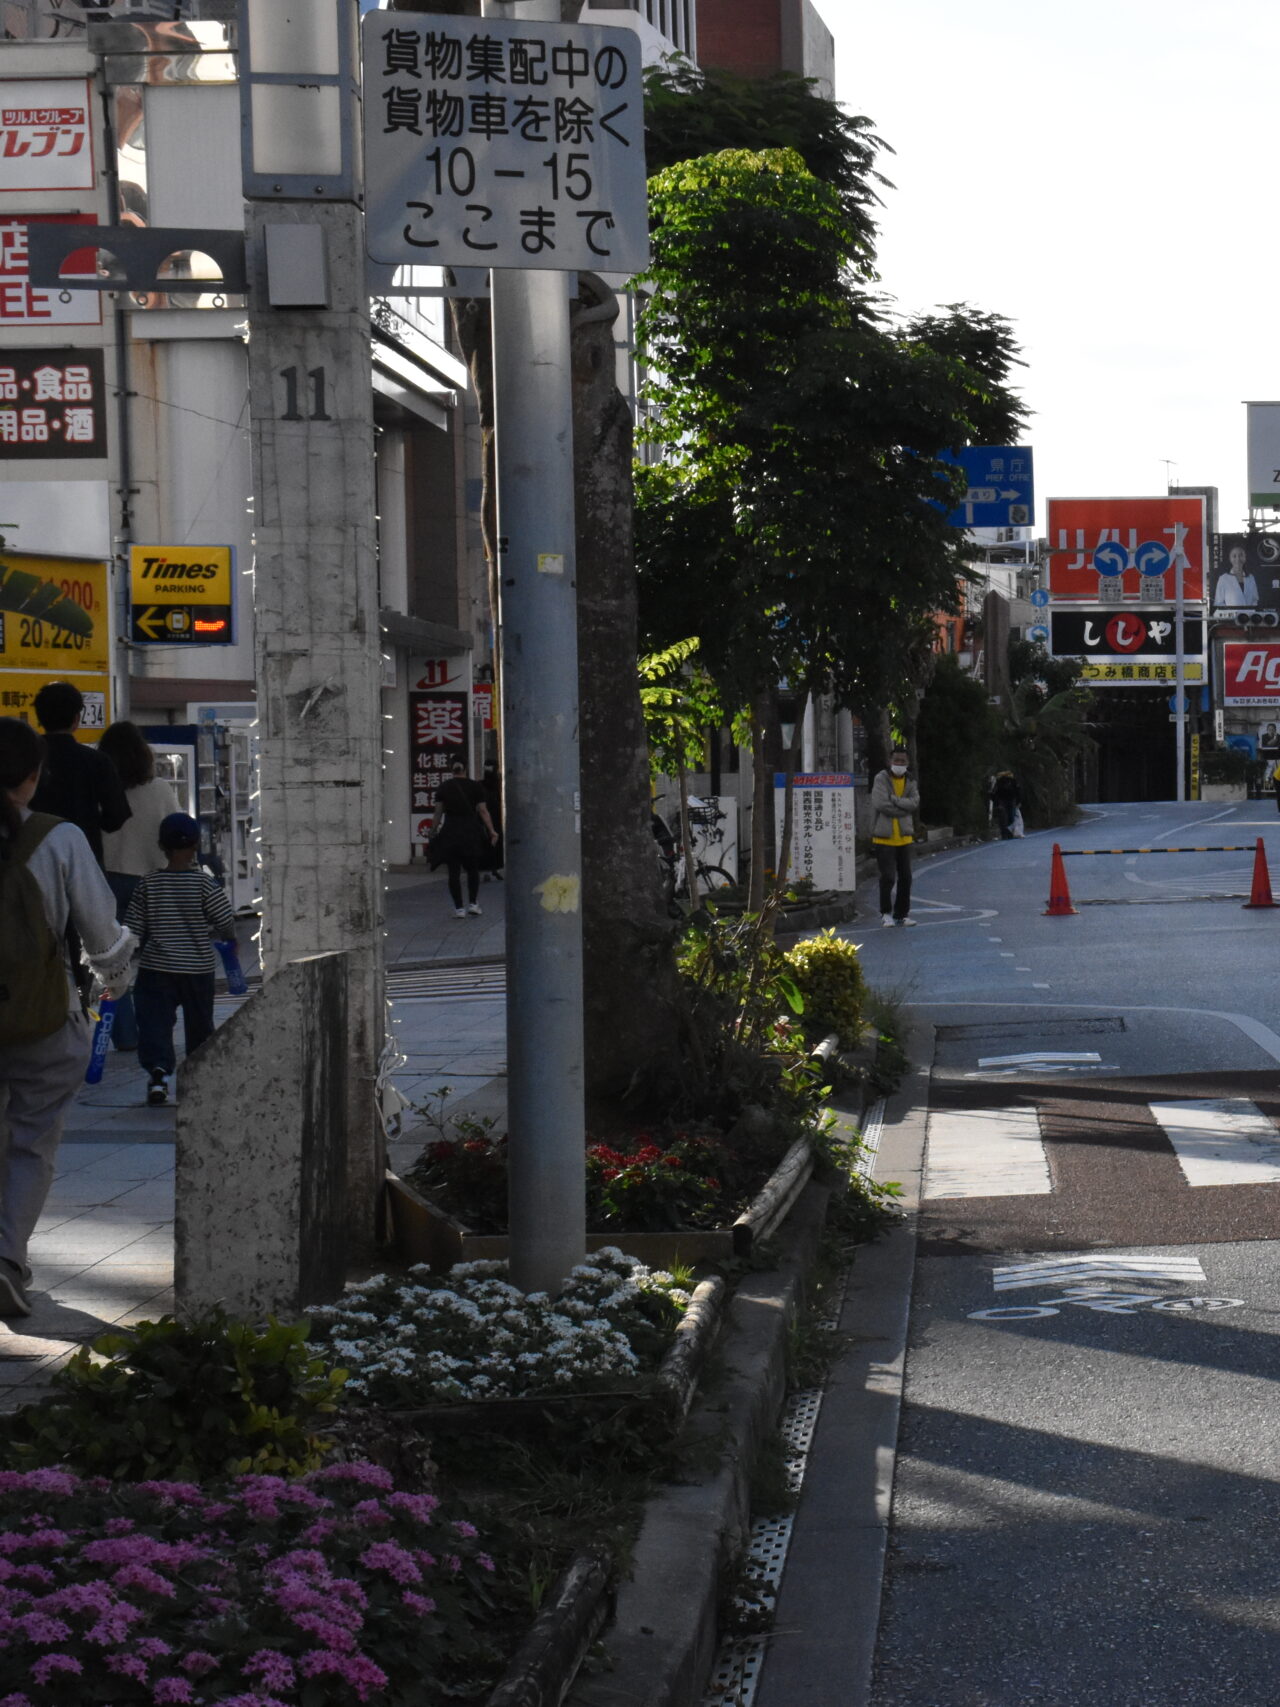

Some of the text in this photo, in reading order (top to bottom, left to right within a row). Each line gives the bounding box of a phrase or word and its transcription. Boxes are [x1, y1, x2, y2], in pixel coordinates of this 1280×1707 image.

[382, 28, 628, 89] 貨物集配中の
[5, 110, 83, 124] ツルハグループ
[382, 86, 630, 147] 貨物車を除く
[0, 126, 85, 157] レブン
[403, 201, 616, 256] ここまで
[279, 365, 333, 422] 11
[990, 458, 1025, 472] 県庁
[141, 557, 219, 579] Times
[154, 584, 206, 593] PARKING
[1083, 620, 1172, 647] ししや
[416, 699, 464, 745] 薬
[417, 753, 455, 769] 化粧
